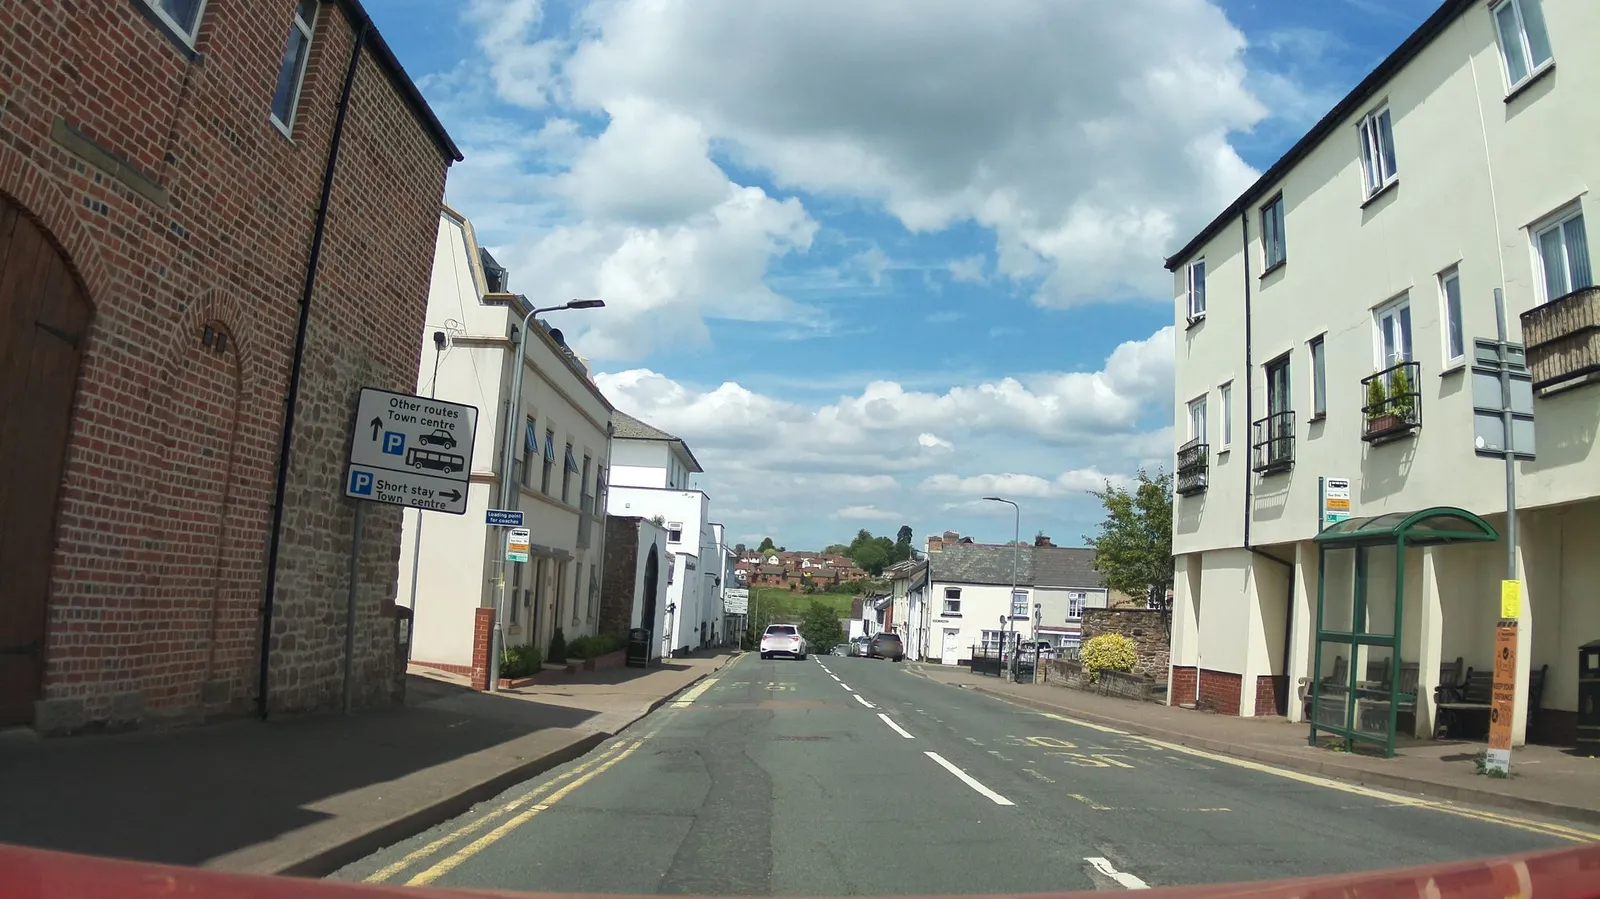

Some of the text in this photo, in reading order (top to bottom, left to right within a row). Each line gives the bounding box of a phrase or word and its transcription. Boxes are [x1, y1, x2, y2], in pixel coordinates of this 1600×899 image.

[389, 397, 459, 419] Other routes
[388, 409, 456, 430] Town centre
[387, 434, 402, 452] P
[355, 474, 370, 492] P
[376, 479, 434, 498] Short stay
[376, 490, 446, 509] Town centre
